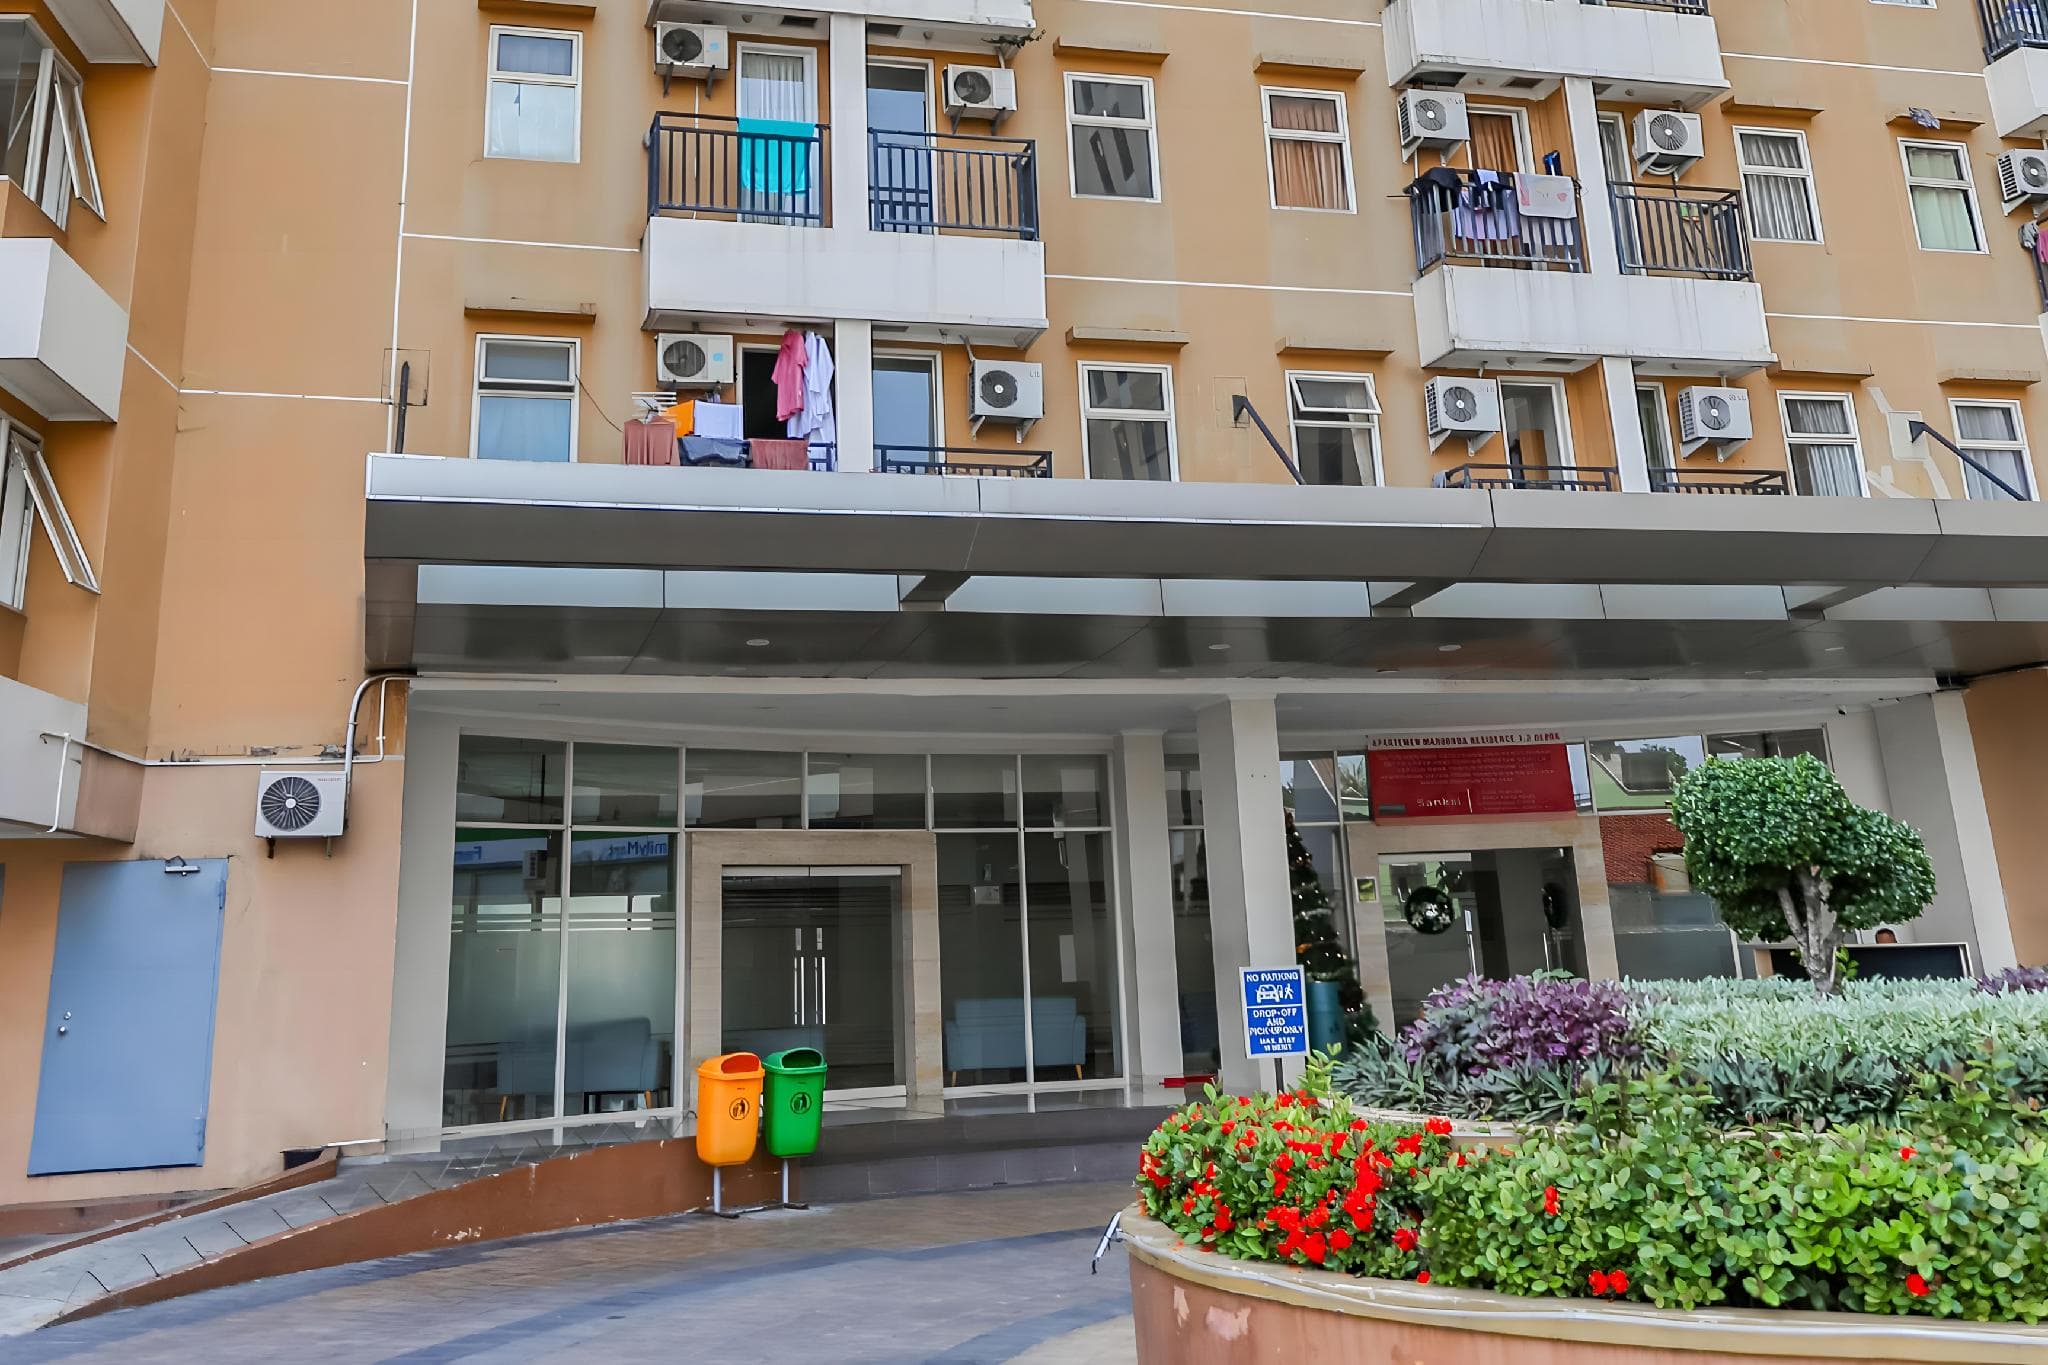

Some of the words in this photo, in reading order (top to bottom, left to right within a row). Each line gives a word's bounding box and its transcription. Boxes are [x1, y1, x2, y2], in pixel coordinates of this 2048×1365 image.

[1246, 973, 1259, 982] NO
[1260, 972, 1299, 982] PARKING
[1253, 1008, 1297, 1017] DROP-OFF
[1266, 1017, 1286, 1027] AND
[1282, 1025, 1304, 1034] ONLY
